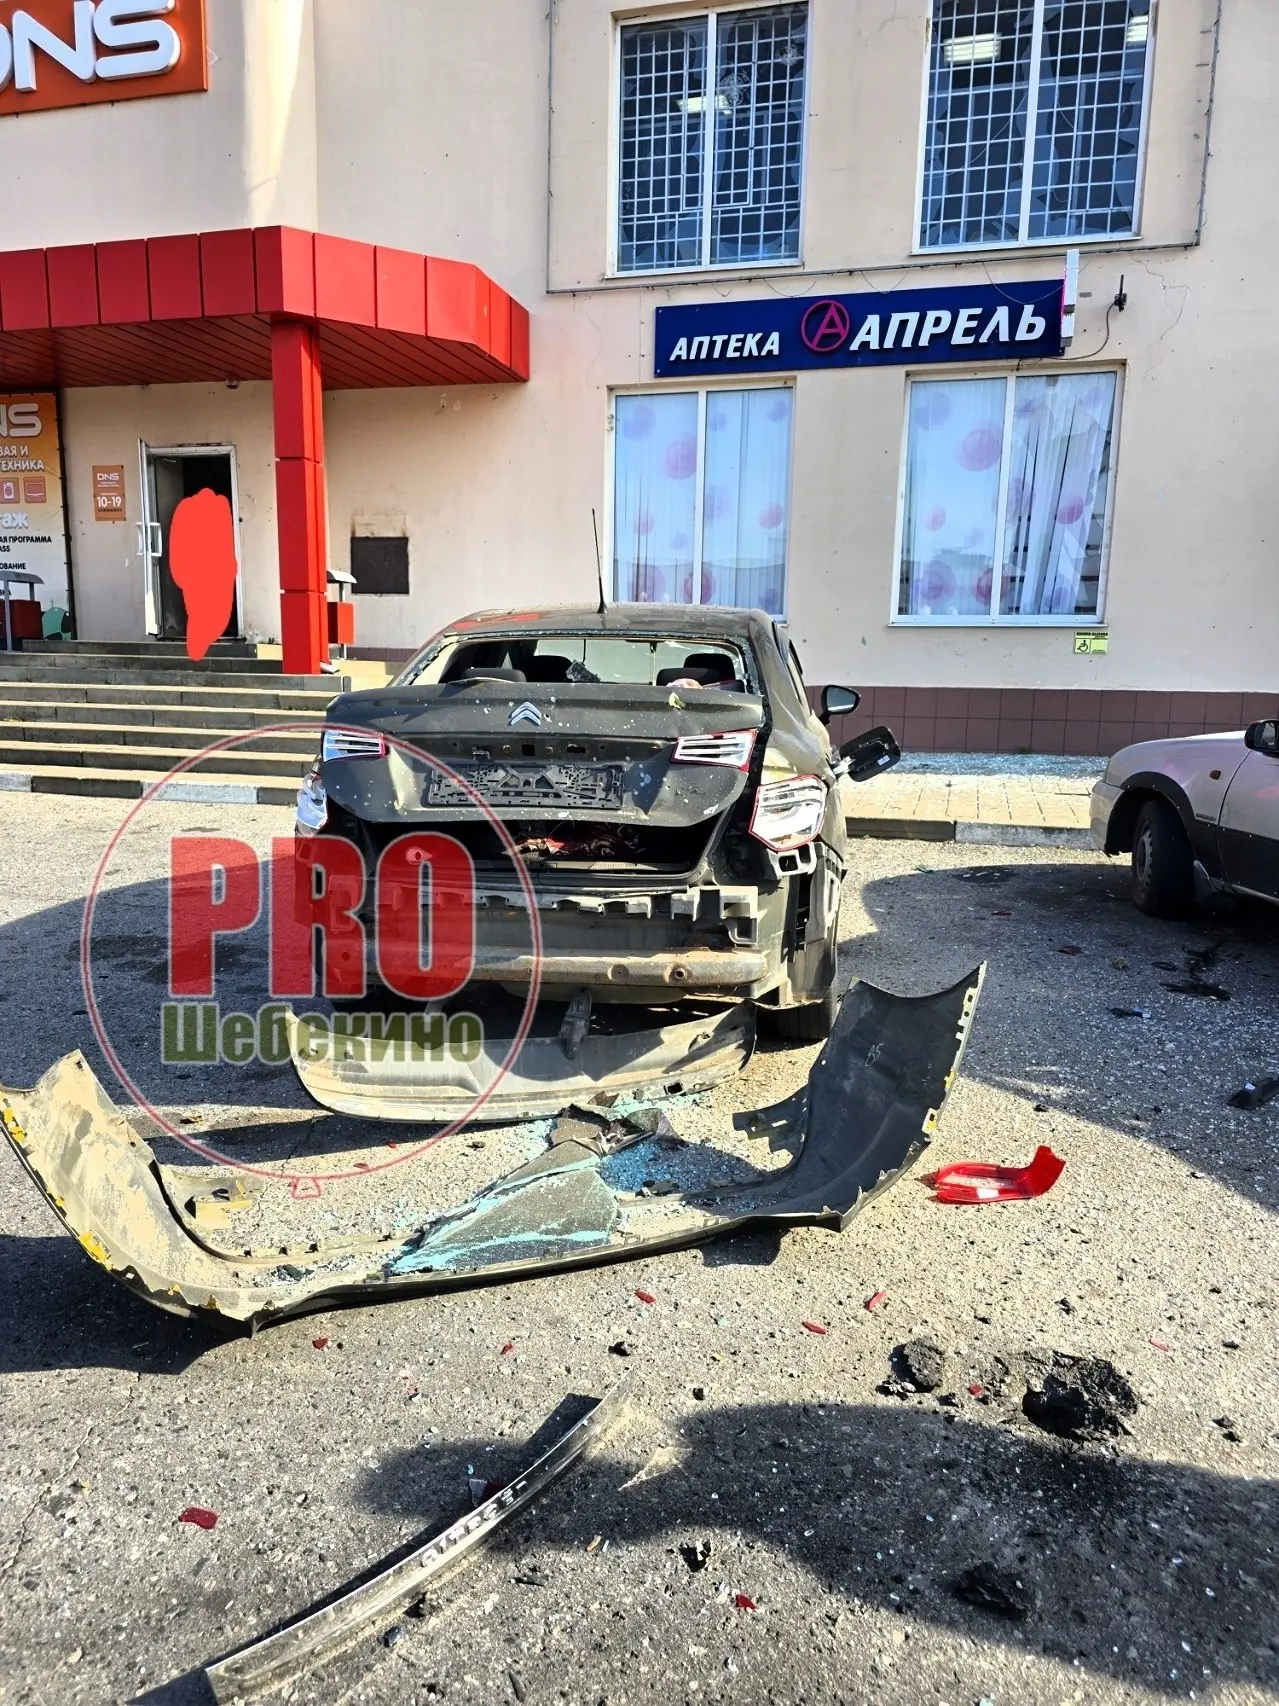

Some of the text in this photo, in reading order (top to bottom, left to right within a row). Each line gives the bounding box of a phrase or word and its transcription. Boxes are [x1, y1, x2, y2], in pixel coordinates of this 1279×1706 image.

[0, 0, 181, 92] NS
[669, 331, 780, 361] АПТЕКА
[849, 304, 1046, 351] АПРЕЛЬ
[0, 402, 42, 437] S
[20, 445, 28, 456] И
[0, 459, 45, 472] ЕХНИКА
[97, 472, 119, 481] DNS
[96, 496, 122, 508] 10-19
[8, 535, 52, 543] ПРОГРАММА
